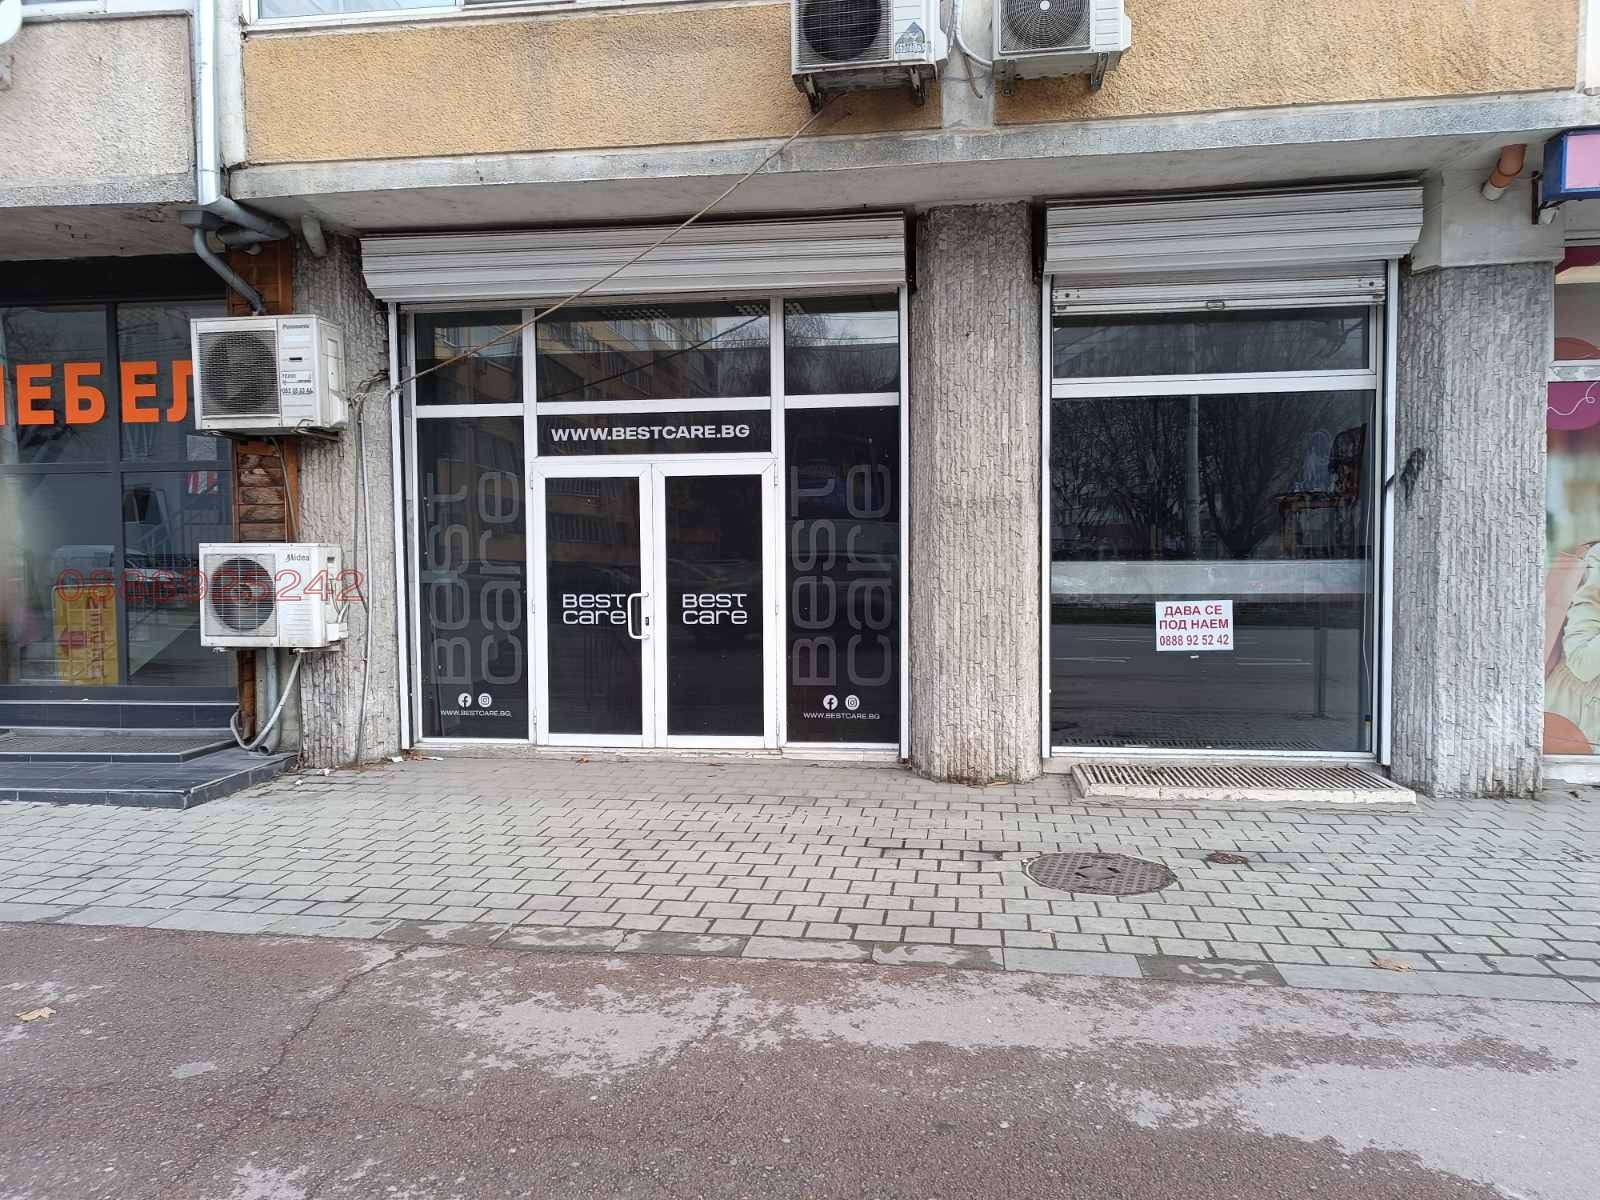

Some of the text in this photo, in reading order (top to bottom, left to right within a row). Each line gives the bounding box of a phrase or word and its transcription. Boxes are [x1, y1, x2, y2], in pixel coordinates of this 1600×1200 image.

[0, 359, 194, 426] ЕБЕЛ
[551, 424, 750, 442] WWW.BESTCARE.BG
[846, 463, 892, 687] care
[562, 610, 627, 625] care
[682, 610, 748, 625] care
[1164, 604, 1223, 618] ДАВА СЕ
[1159, 618, 1229, 631] ПОД НАЕМ
[1159, 634, 1230, 646] 0888 92 52 42
[803, 711, 881, 720] WWW.BESTCARE.BG
